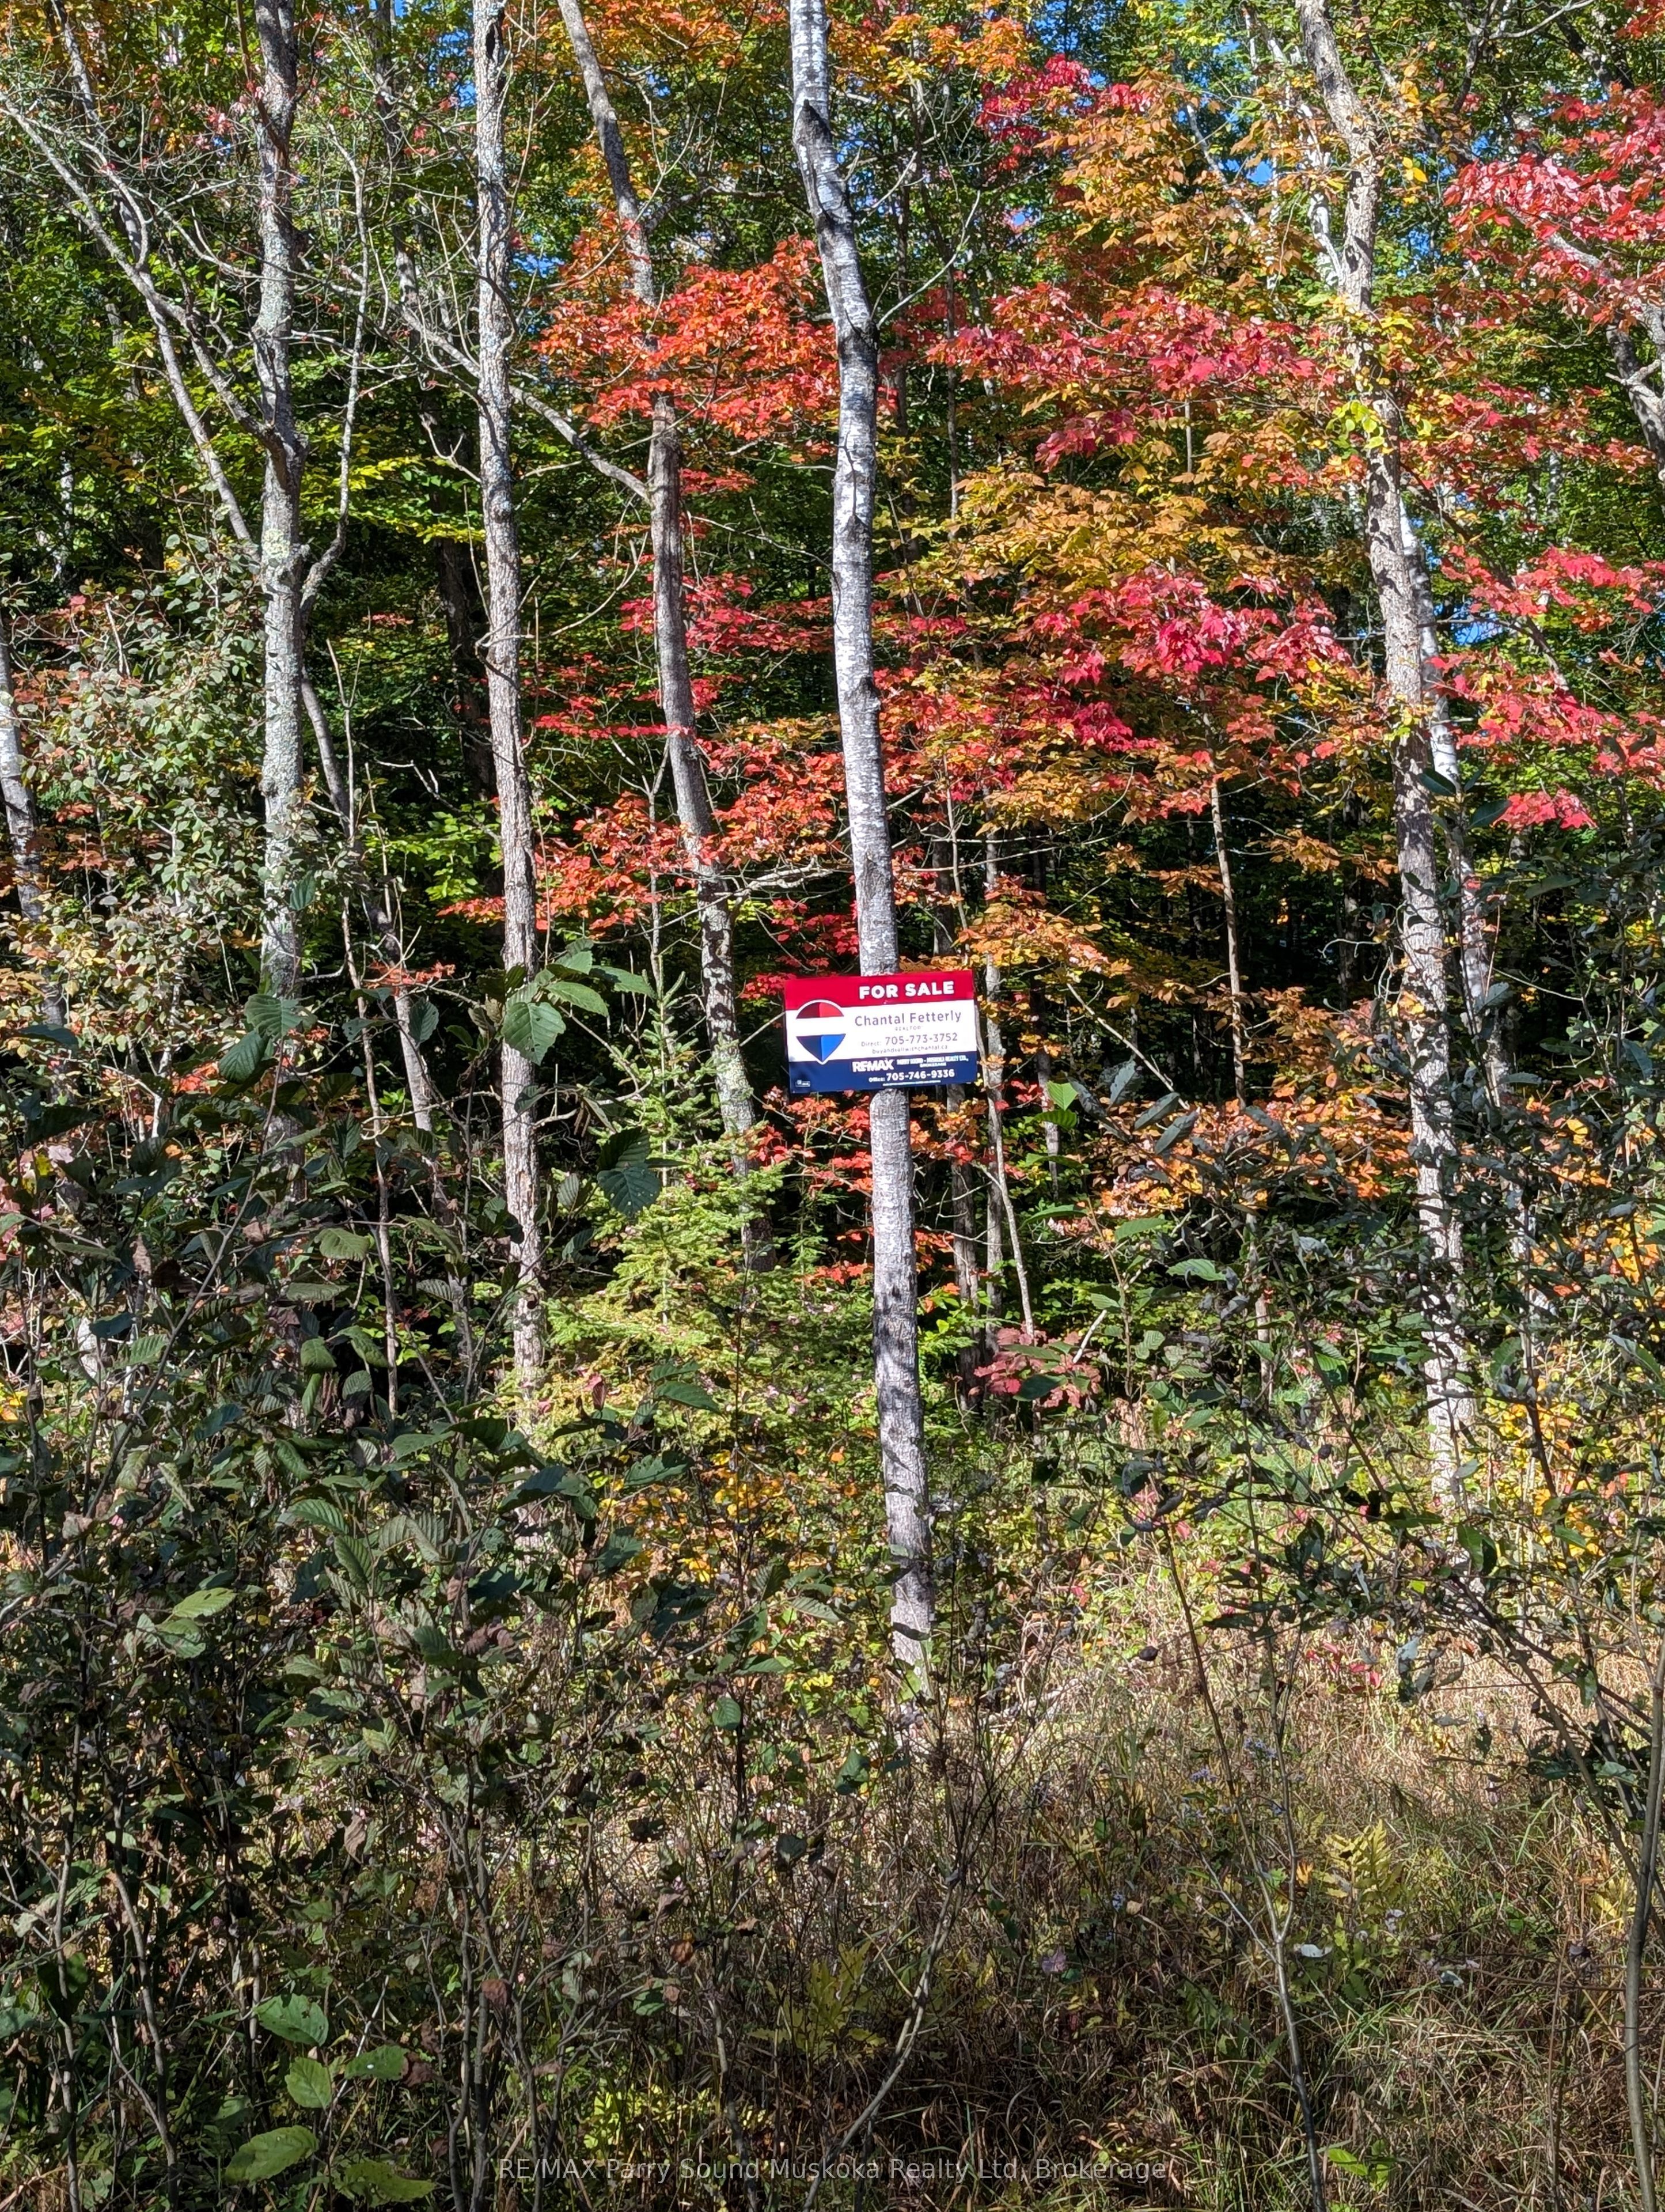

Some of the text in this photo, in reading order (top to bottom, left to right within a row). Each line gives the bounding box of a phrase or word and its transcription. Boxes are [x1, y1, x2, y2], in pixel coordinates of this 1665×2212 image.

[859, 980, 954, 999] FOR SALE
[855, 1010, 961, 1027] Chantal Fetterly
[885, 1032, 958, 1046] 705-773-3752
[886, 1069, 955, 1081] 705-746-9336
